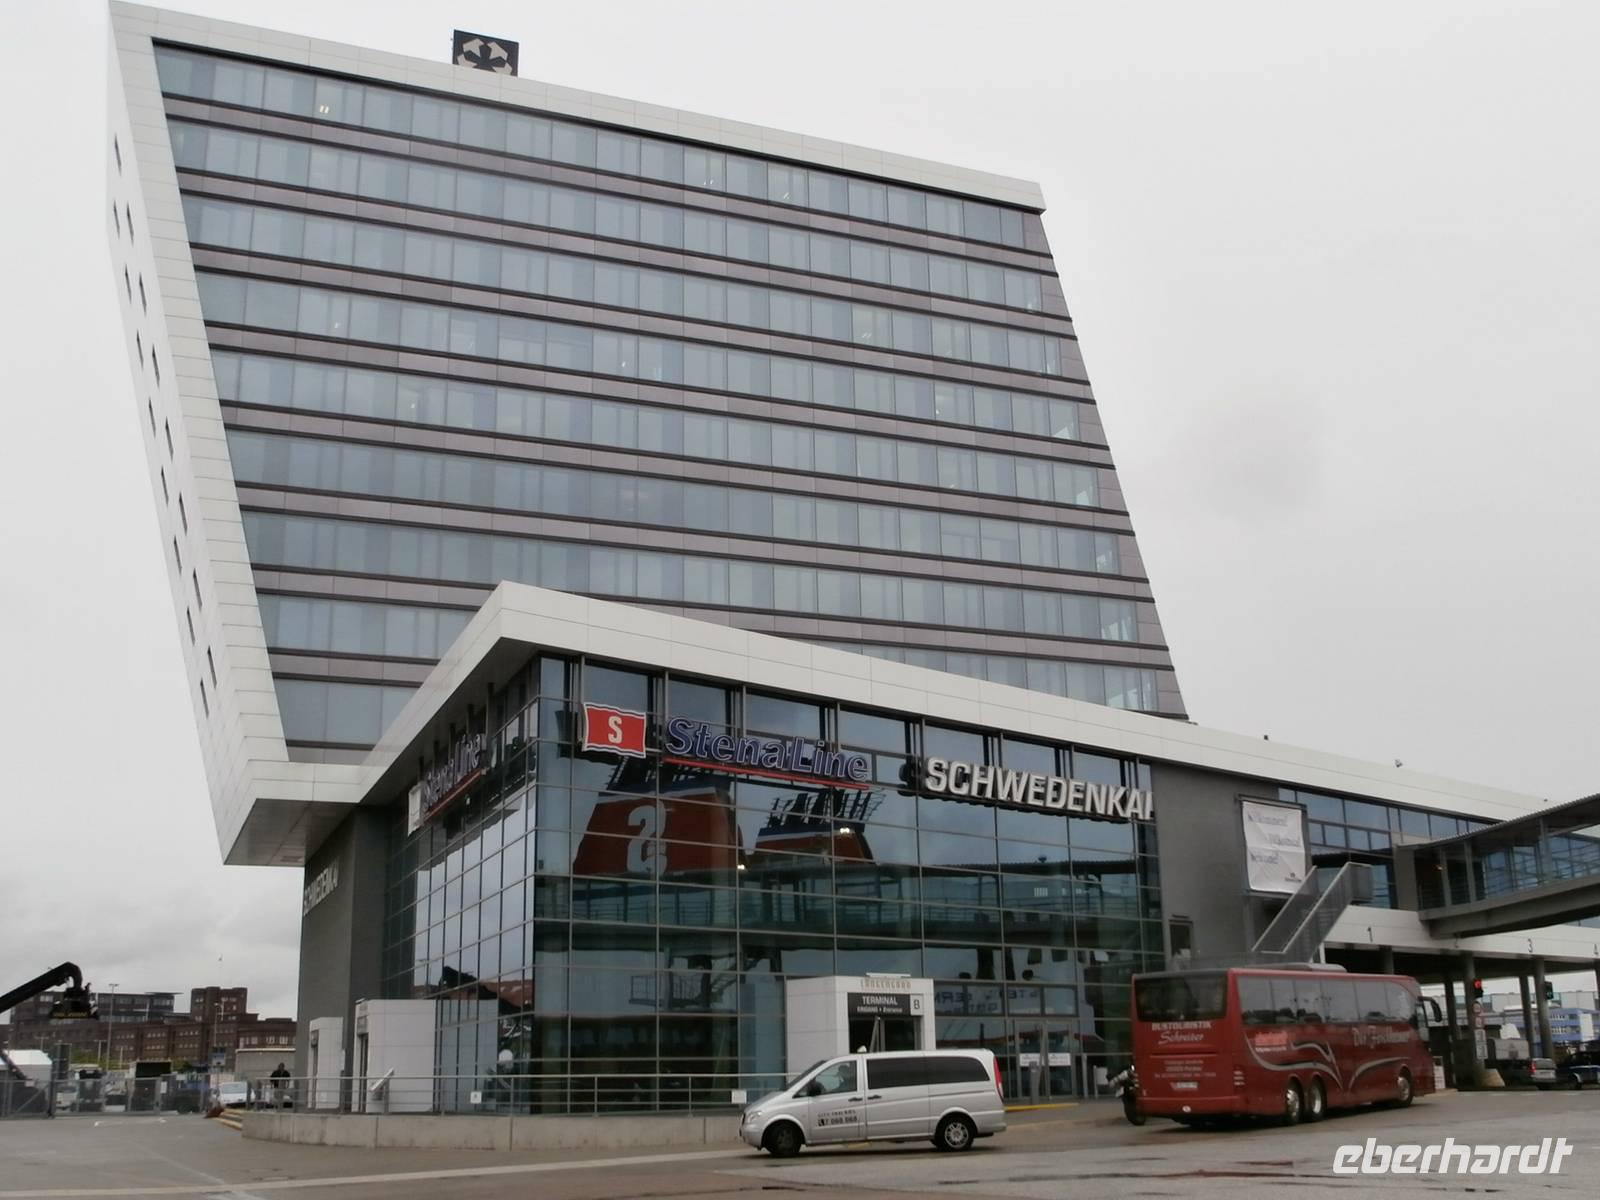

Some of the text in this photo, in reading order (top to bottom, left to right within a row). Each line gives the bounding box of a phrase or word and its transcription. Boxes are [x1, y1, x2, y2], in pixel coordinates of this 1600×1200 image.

[607, 714, 624, 745] S
[925, 756, 1154, 821] SCHWEDENKAI
[861, 995, 898, 1006] TERMINAL
